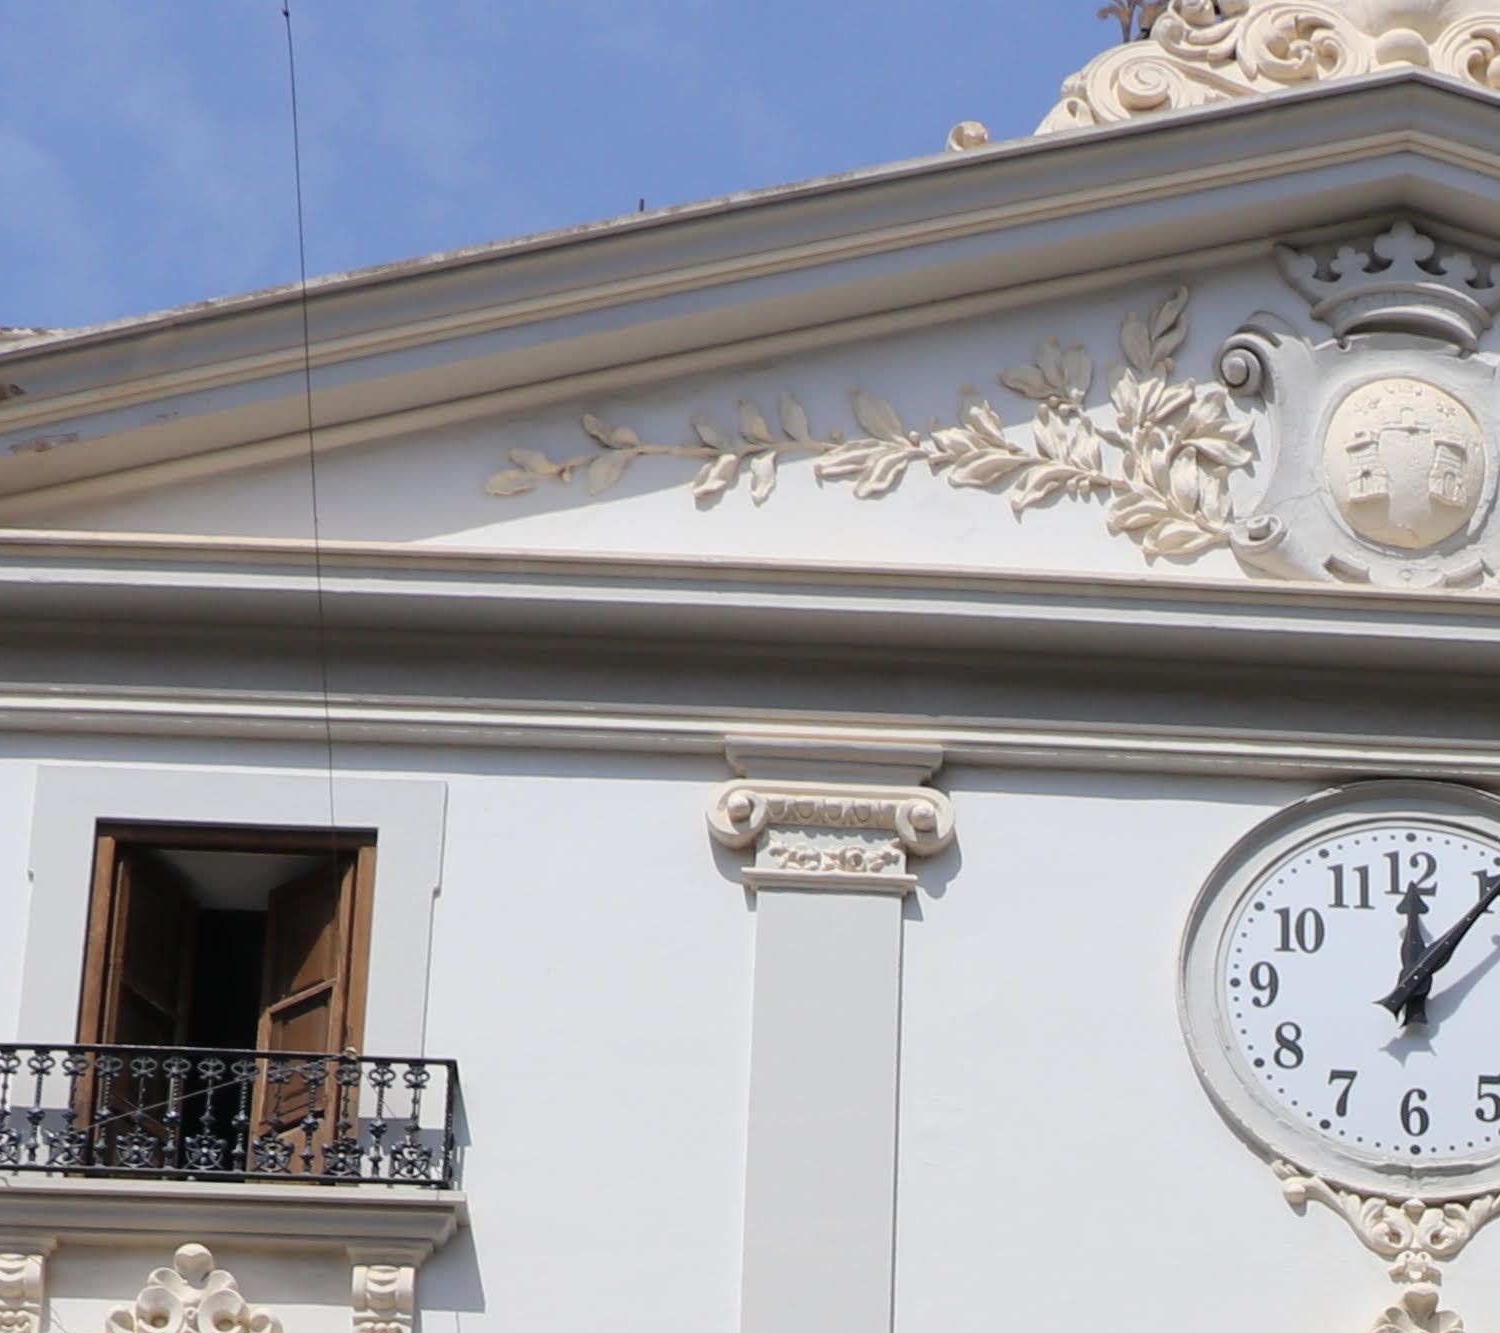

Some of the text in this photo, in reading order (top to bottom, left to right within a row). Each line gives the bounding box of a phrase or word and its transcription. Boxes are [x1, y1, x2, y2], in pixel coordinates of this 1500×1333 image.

[1327, 864, 1375, 909] 11
[1383, 850, 1437, 897] 12
[1274, 908, 1324, 953] 10
[1250, 961, 1279, 1007] 9
[1273, 1022, 1303, 1069] 8
[1328, 1070, 1357, 1117] 7
[1401, 1089, 1429, 1136] 6
